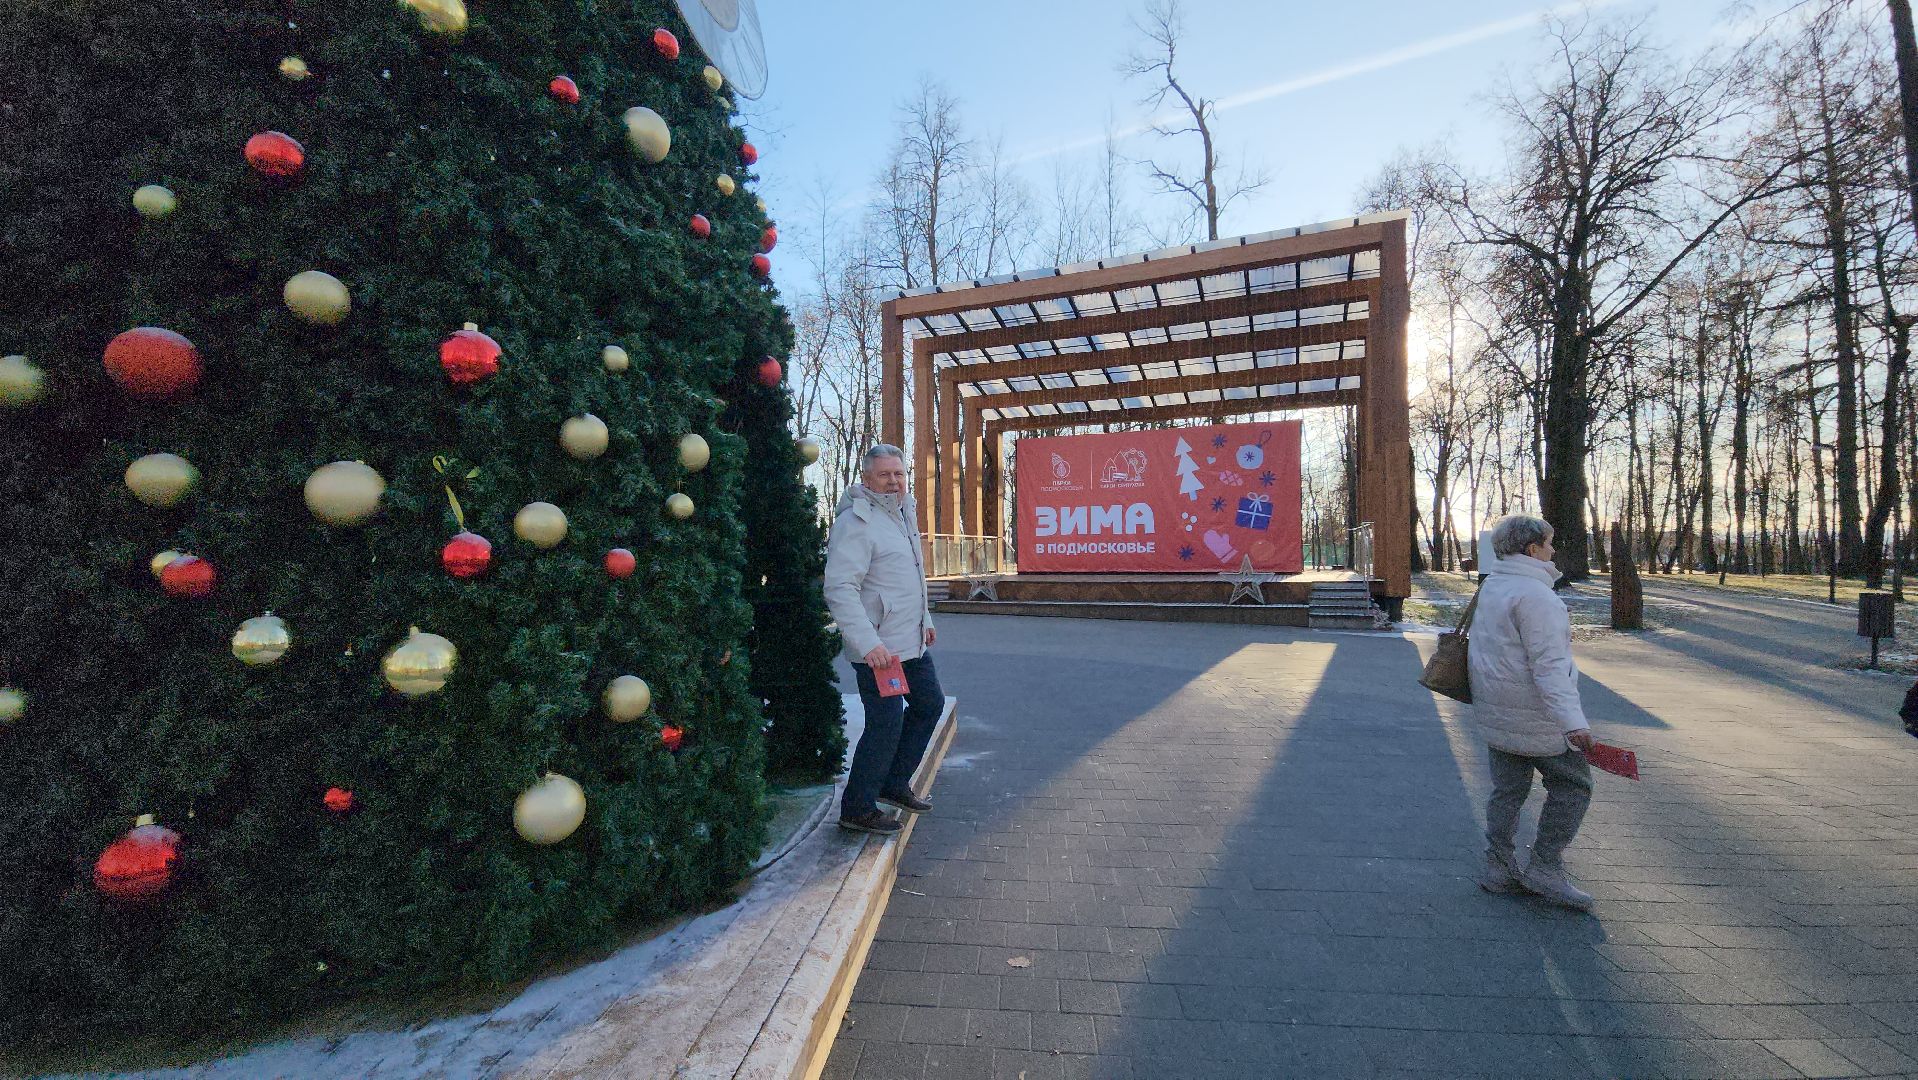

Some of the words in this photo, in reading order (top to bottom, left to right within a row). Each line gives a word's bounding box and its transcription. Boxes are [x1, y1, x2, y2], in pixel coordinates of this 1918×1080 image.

[1035, 502, 1156, 537] ЗИМА
[1035, 543, 1045, 554] В
[1047, 541, 1156, 556] ПОДМОСКОВЬЕ
